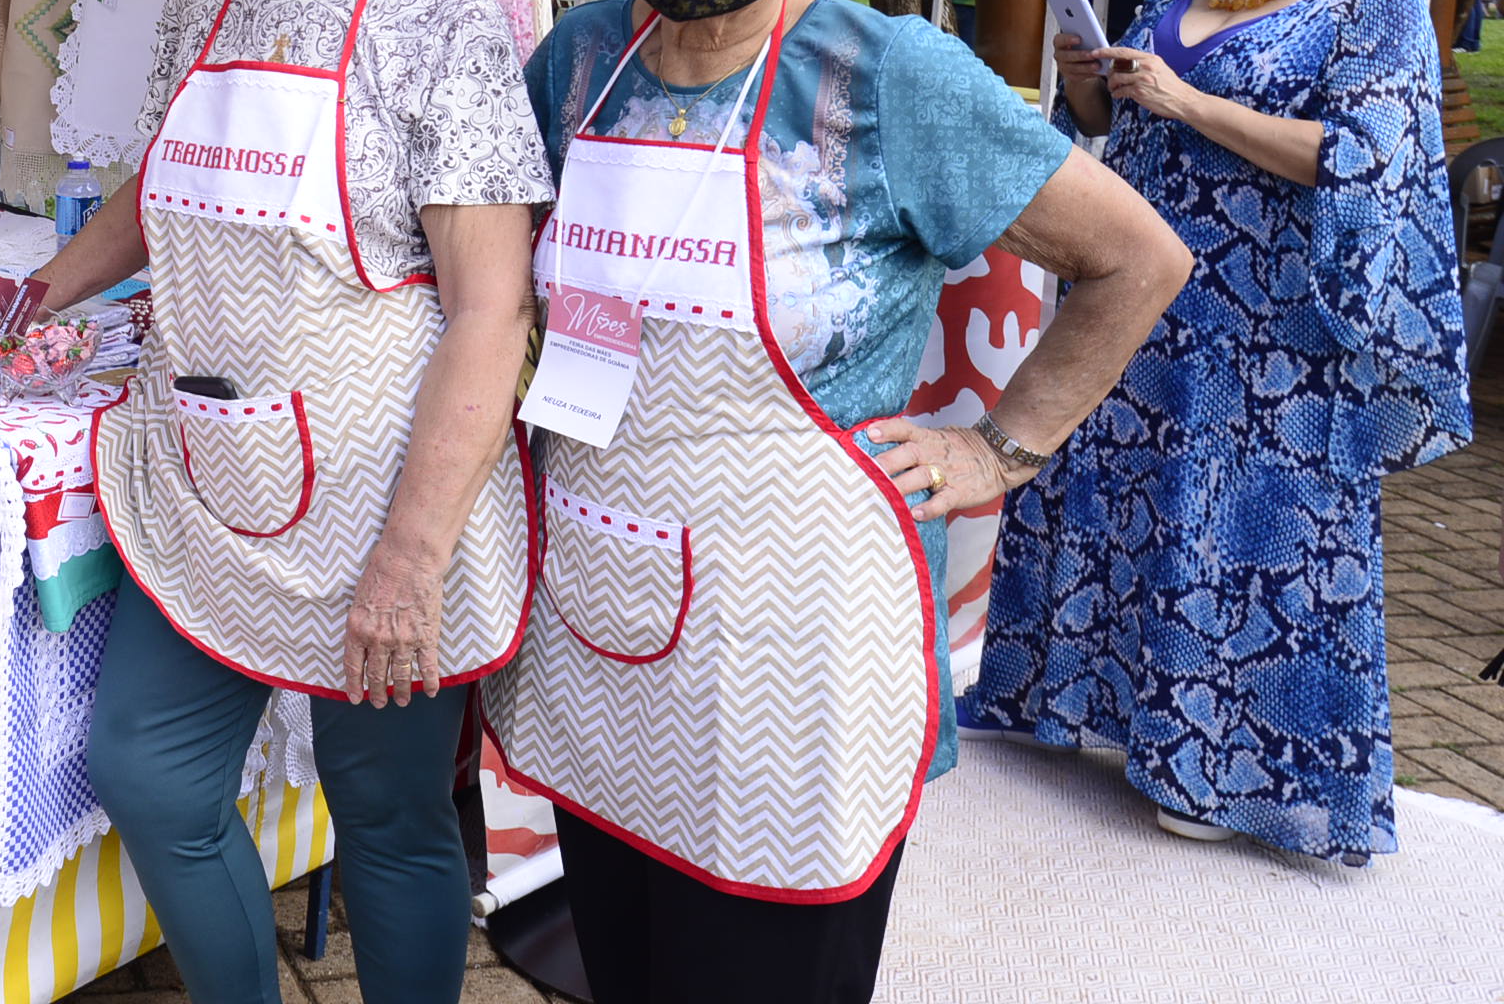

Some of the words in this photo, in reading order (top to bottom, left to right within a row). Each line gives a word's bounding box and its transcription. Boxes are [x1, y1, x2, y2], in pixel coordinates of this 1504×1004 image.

[162, 139, 305, 177] TRAMANOSSA
[547, 217, 737, 267] RAMANOSSA
[563, 293, 630, 336] Mães
[550, 341, 598, 360] EMPREENDEDORAS
[599, 355, 607, 363] DE
[569, 340, 584, 349] FEIRA
[584, 344, 596, 353] DAS
[542, 395, 567, 409] NEUZA
[569, 404, 602, 421] TEIXEIRA
